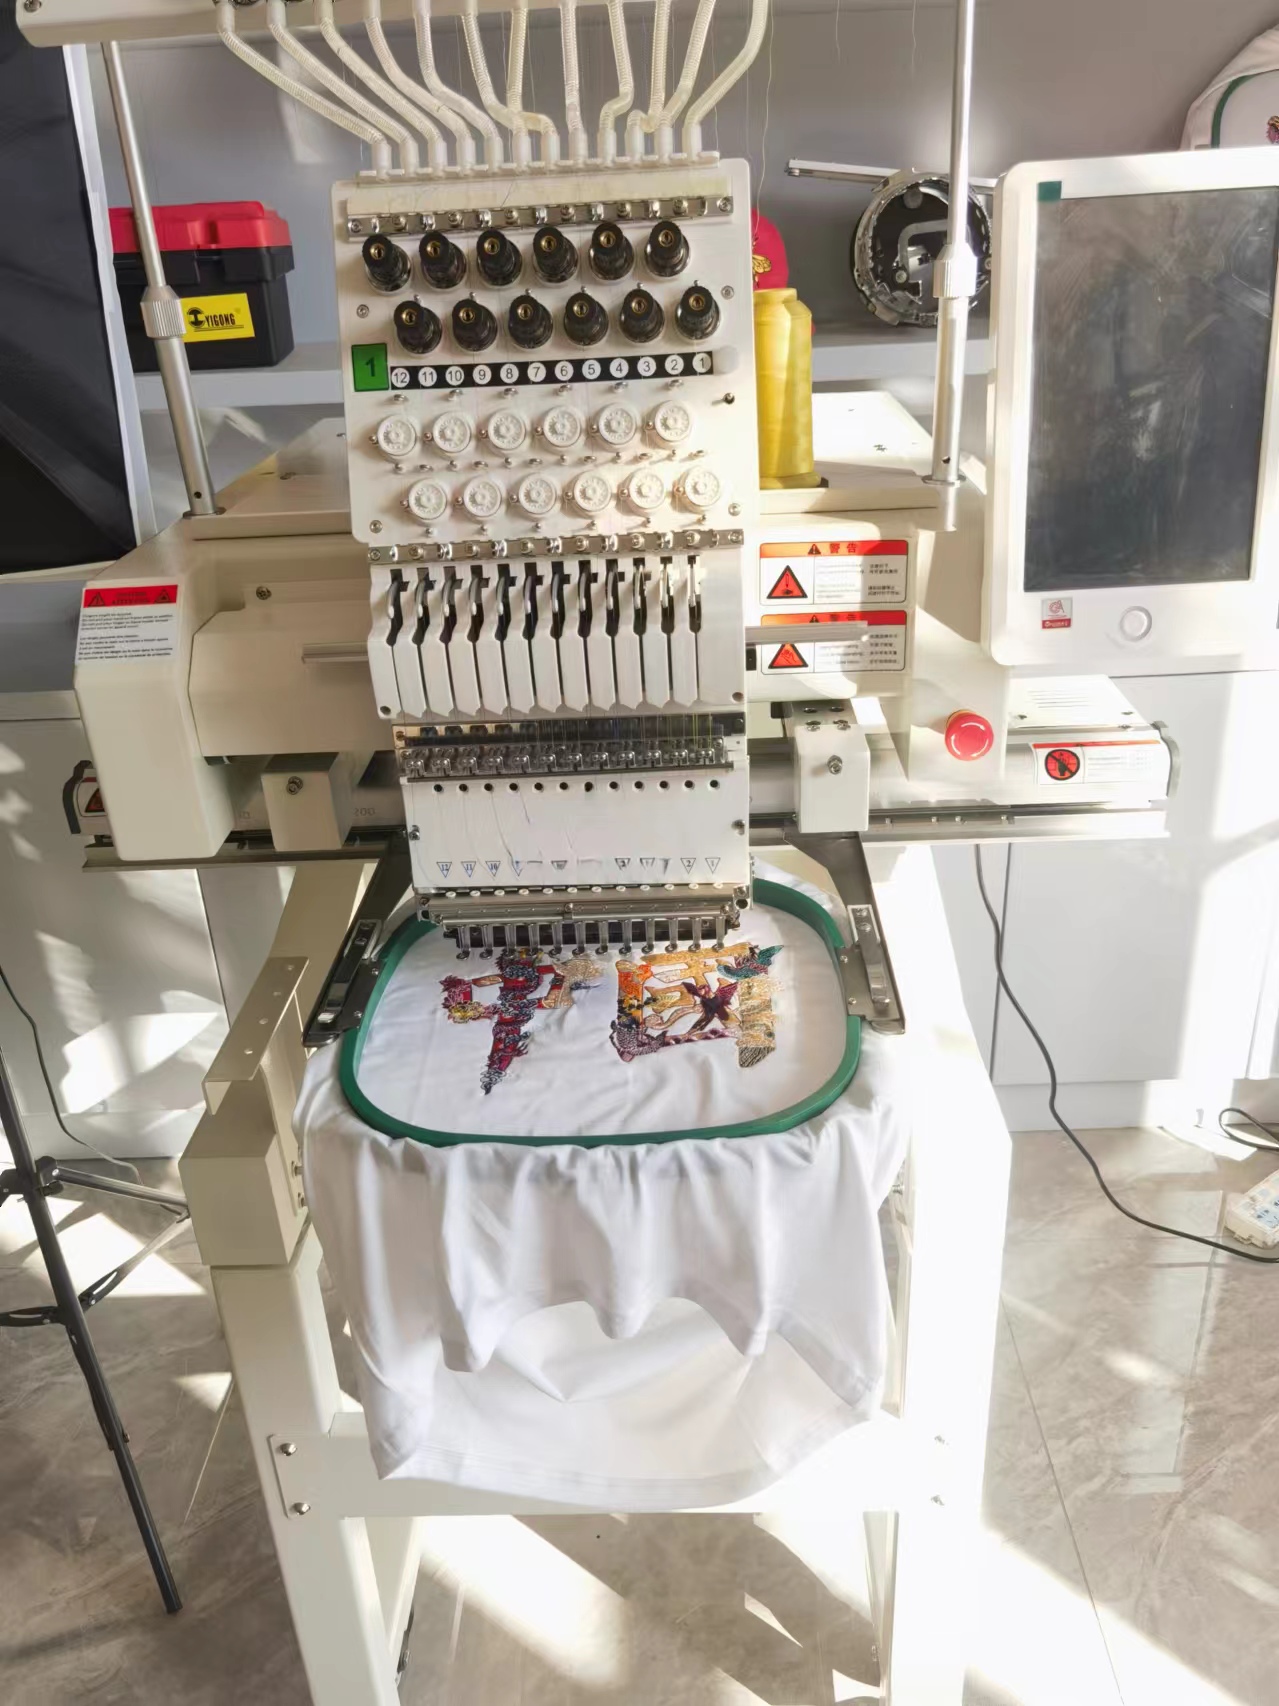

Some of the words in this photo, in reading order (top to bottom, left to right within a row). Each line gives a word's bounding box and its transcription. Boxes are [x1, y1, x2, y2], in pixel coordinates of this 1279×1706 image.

[205, 313, 236, 327] YIGONG
[365, 356, 375, 377] 1
[393, 371, 408, 384] 12
[421, 370, 435, 383] 11
[448, 370, 463, 382] 10
[478, 369, 487, 381] 9
[505, 368, 514, 380] 8
[532, 366, 541, 378] 7
[560, 365, 569, 377] 6
[587, 363, 596, 375] 5
[615, 362, 623, 374] 4
[643, 361, 651, 373] 3
[670, 359, 679, 371] 2
[699, 357, 706, 369] 1
[440, 863, 449, 872] 12
